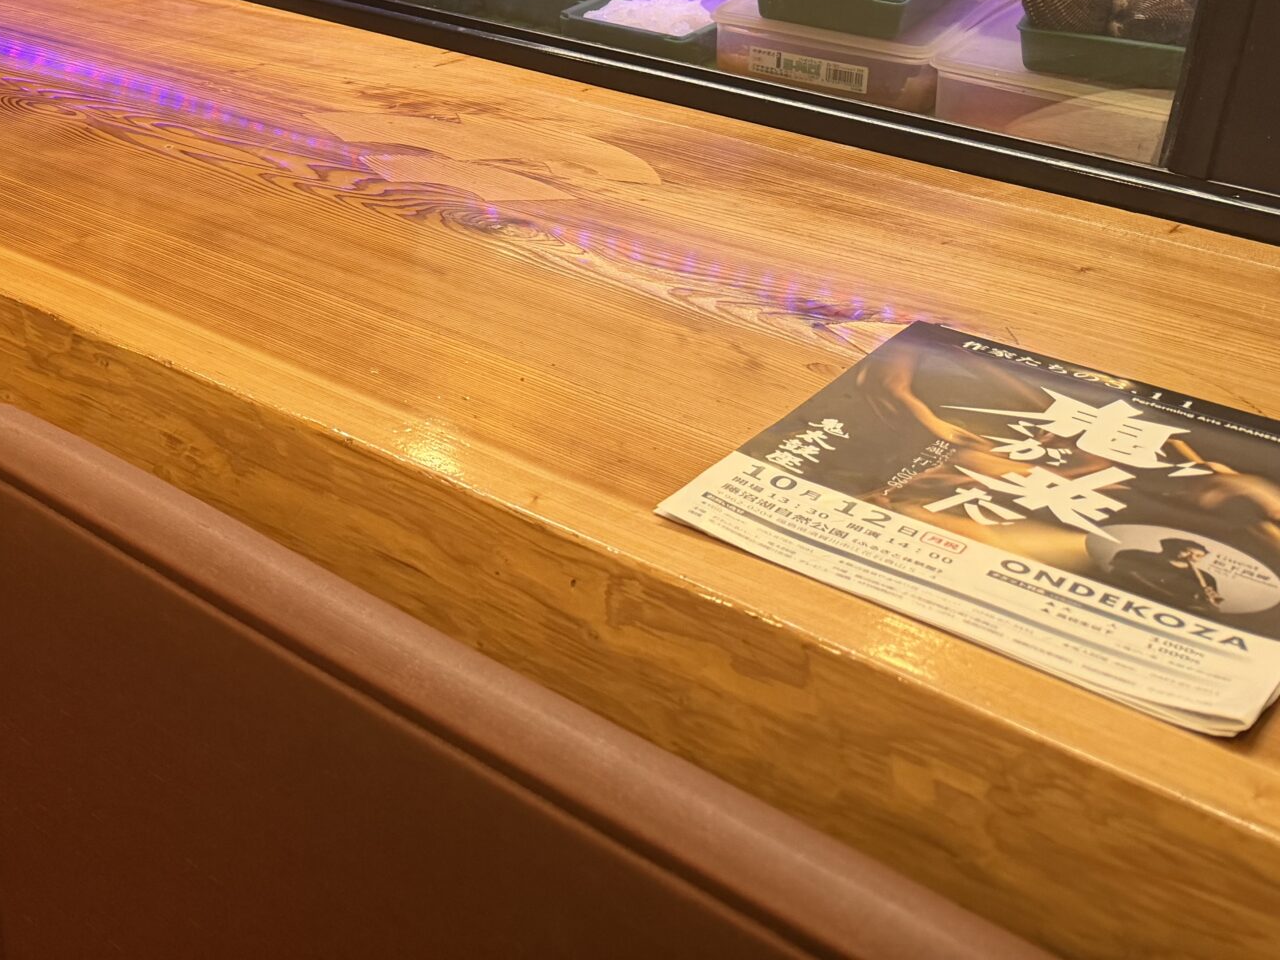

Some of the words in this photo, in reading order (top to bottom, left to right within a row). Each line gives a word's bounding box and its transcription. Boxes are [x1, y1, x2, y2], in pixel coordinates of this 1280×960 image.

[1132, 397, 1195, 419] Performing
[1196, 415, 1222, 426] Arts
[1000, 559, 1249, 652] ONDEKOZA
